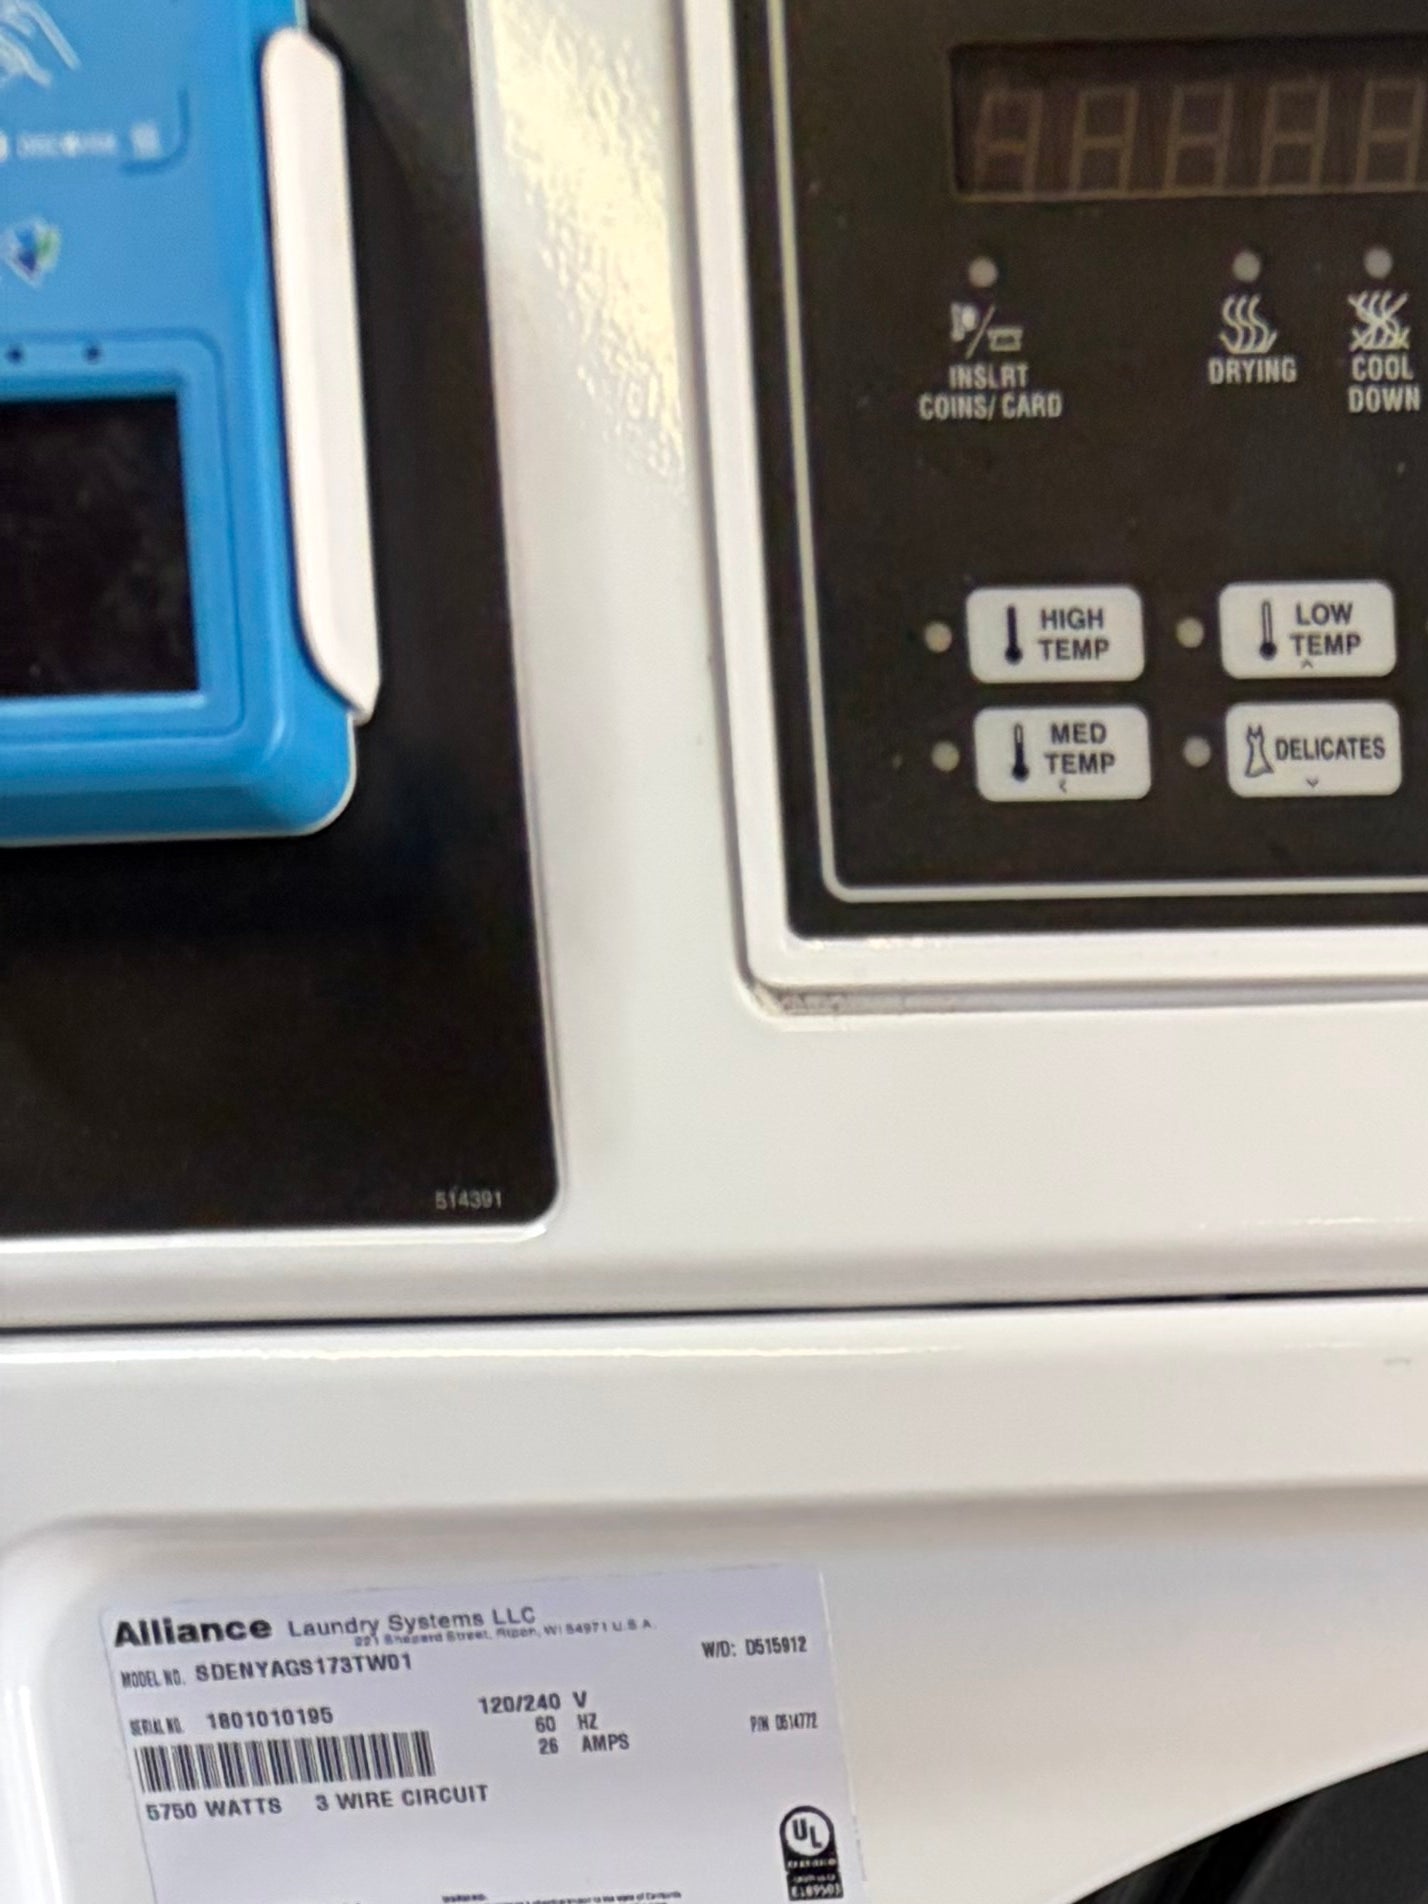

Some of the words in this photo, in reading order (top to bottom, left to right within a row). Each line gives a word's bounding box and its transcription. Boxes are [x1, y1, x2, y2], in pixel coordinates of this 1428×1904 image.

[1208, 356, 1298, 385] DRYING
[1351, 355, 1414, 381] COOL
[1347, 385, 1421, 414] DOWN
[1039, 607, 1105, 631] HIGH
[1295, 603, 1354, 627] LOW
[1037, 639, 1110, 663] TEMP
[1289, 634, 1361, 658] TEMP
[1050, 722, 1108, 745] MED
[1273, 736, 1387, 762] DELICATES
[1043, 751, 1117, 777] TEMP
[114, 1617, 273, 1648] Alliance
[288, 1616, 379, 1640] Laundry
[388, 1611, 485, 1635] Systems
[492, 1606, 536, 1625] LLC
[120, 1669, 162, 1689] MODEL
[163, 1669, 186, 1688] NO.
[478, 1693, 561, 1715] 120/240
[572, 1691, 588, 1709] V
[206, 1707, 334, 1731] 1801010195
[535, 1715, 556, 1734] 60
[577, 1712, 598, 1731] HZ
[538, 1736, 559, 1755] 26
[581, 1733, 630, 1753] AMPS
[145, 1802, 198, 1822] 5750
[205, 1797, 283, 1818] WATTS
[315, 1793, 330, 1813] 3
[335, 1790, 394, 1811] WIRE
[401, 1784, 489, 1807] CIRCUIT
[792, 1818, 823, 1849] UL
